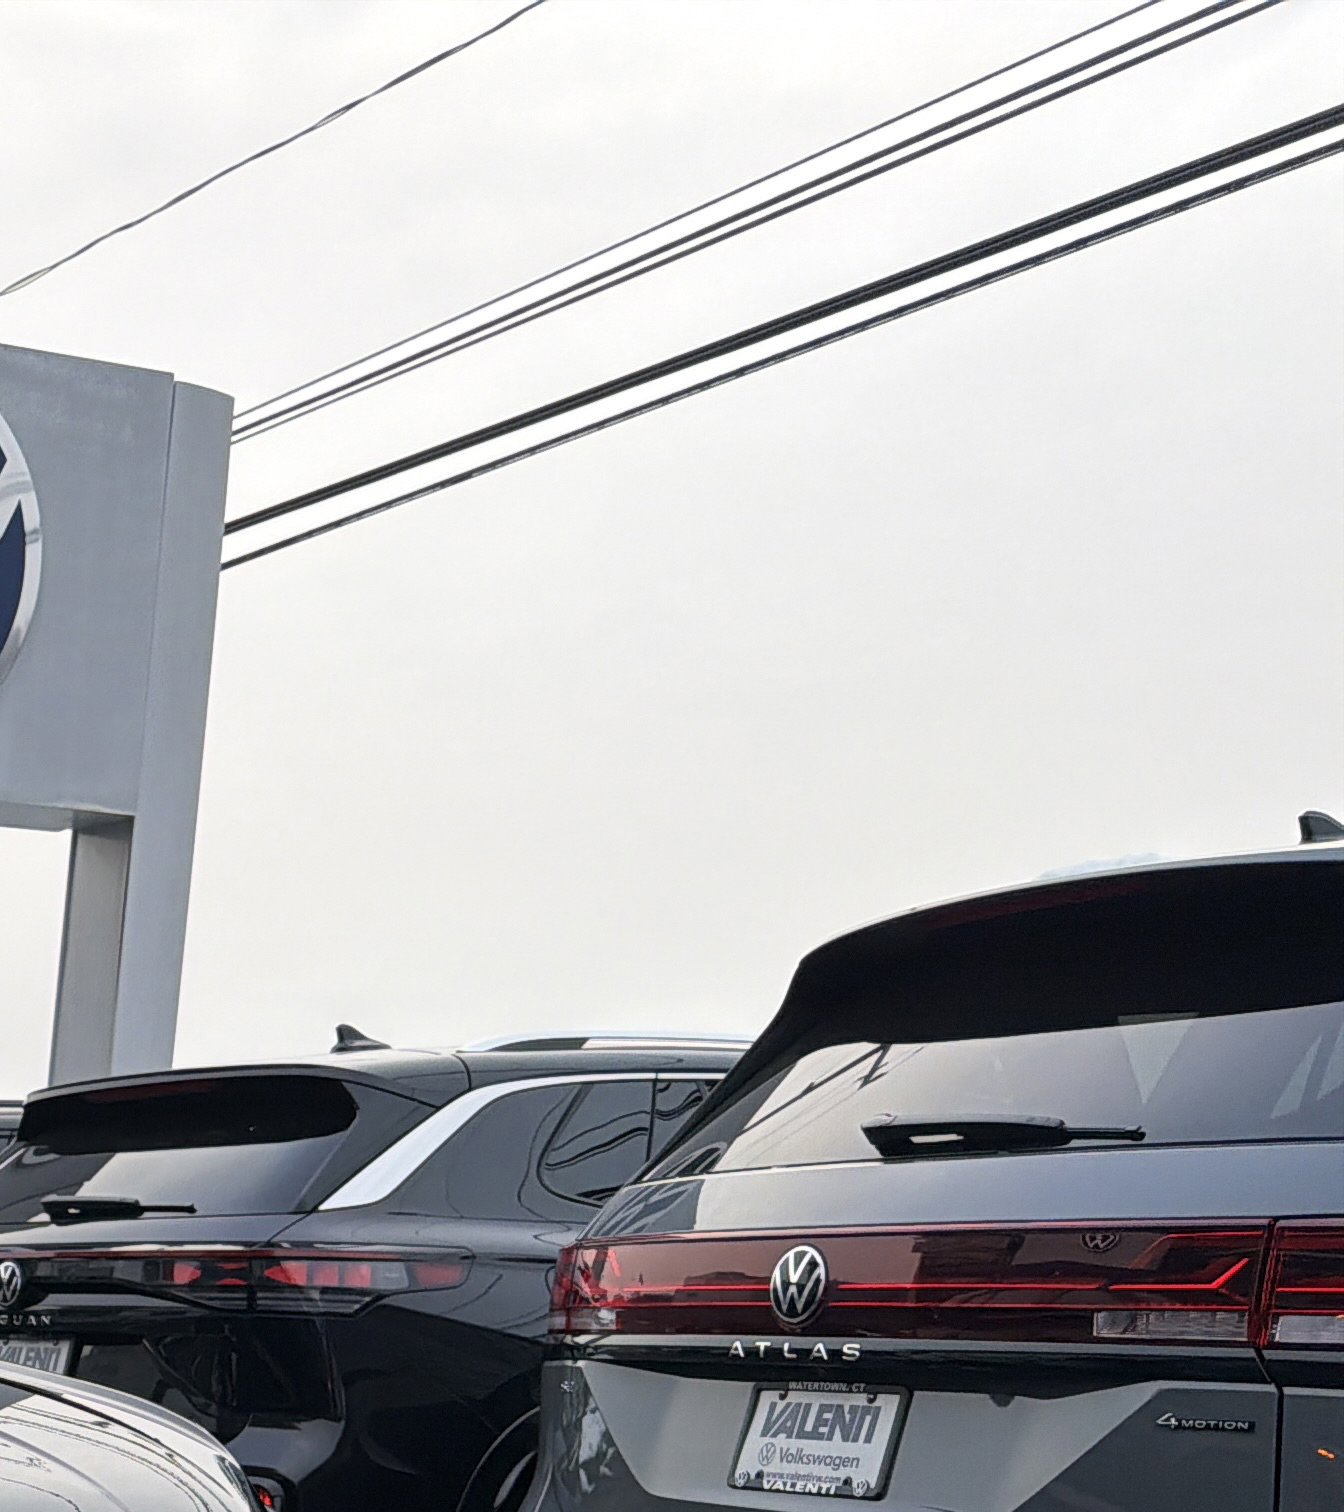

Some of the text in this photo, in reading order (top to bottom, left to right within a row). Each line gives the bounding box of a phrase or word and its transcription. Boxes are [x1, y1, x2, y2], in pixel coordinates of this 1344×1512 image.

[772, 1249, 825, 1317] VW
[728, 1340, 861, 1361] ATLAS
[852, 1383, 866, 1392] CT
[760, 1402, 882, 1444] VALENTI
[1156, 1412, 1249, 1430] 4MOTION
[779, 1447, 860, 1471] Volkswagen
[763, 1480, 836, 1495] VALENTI
